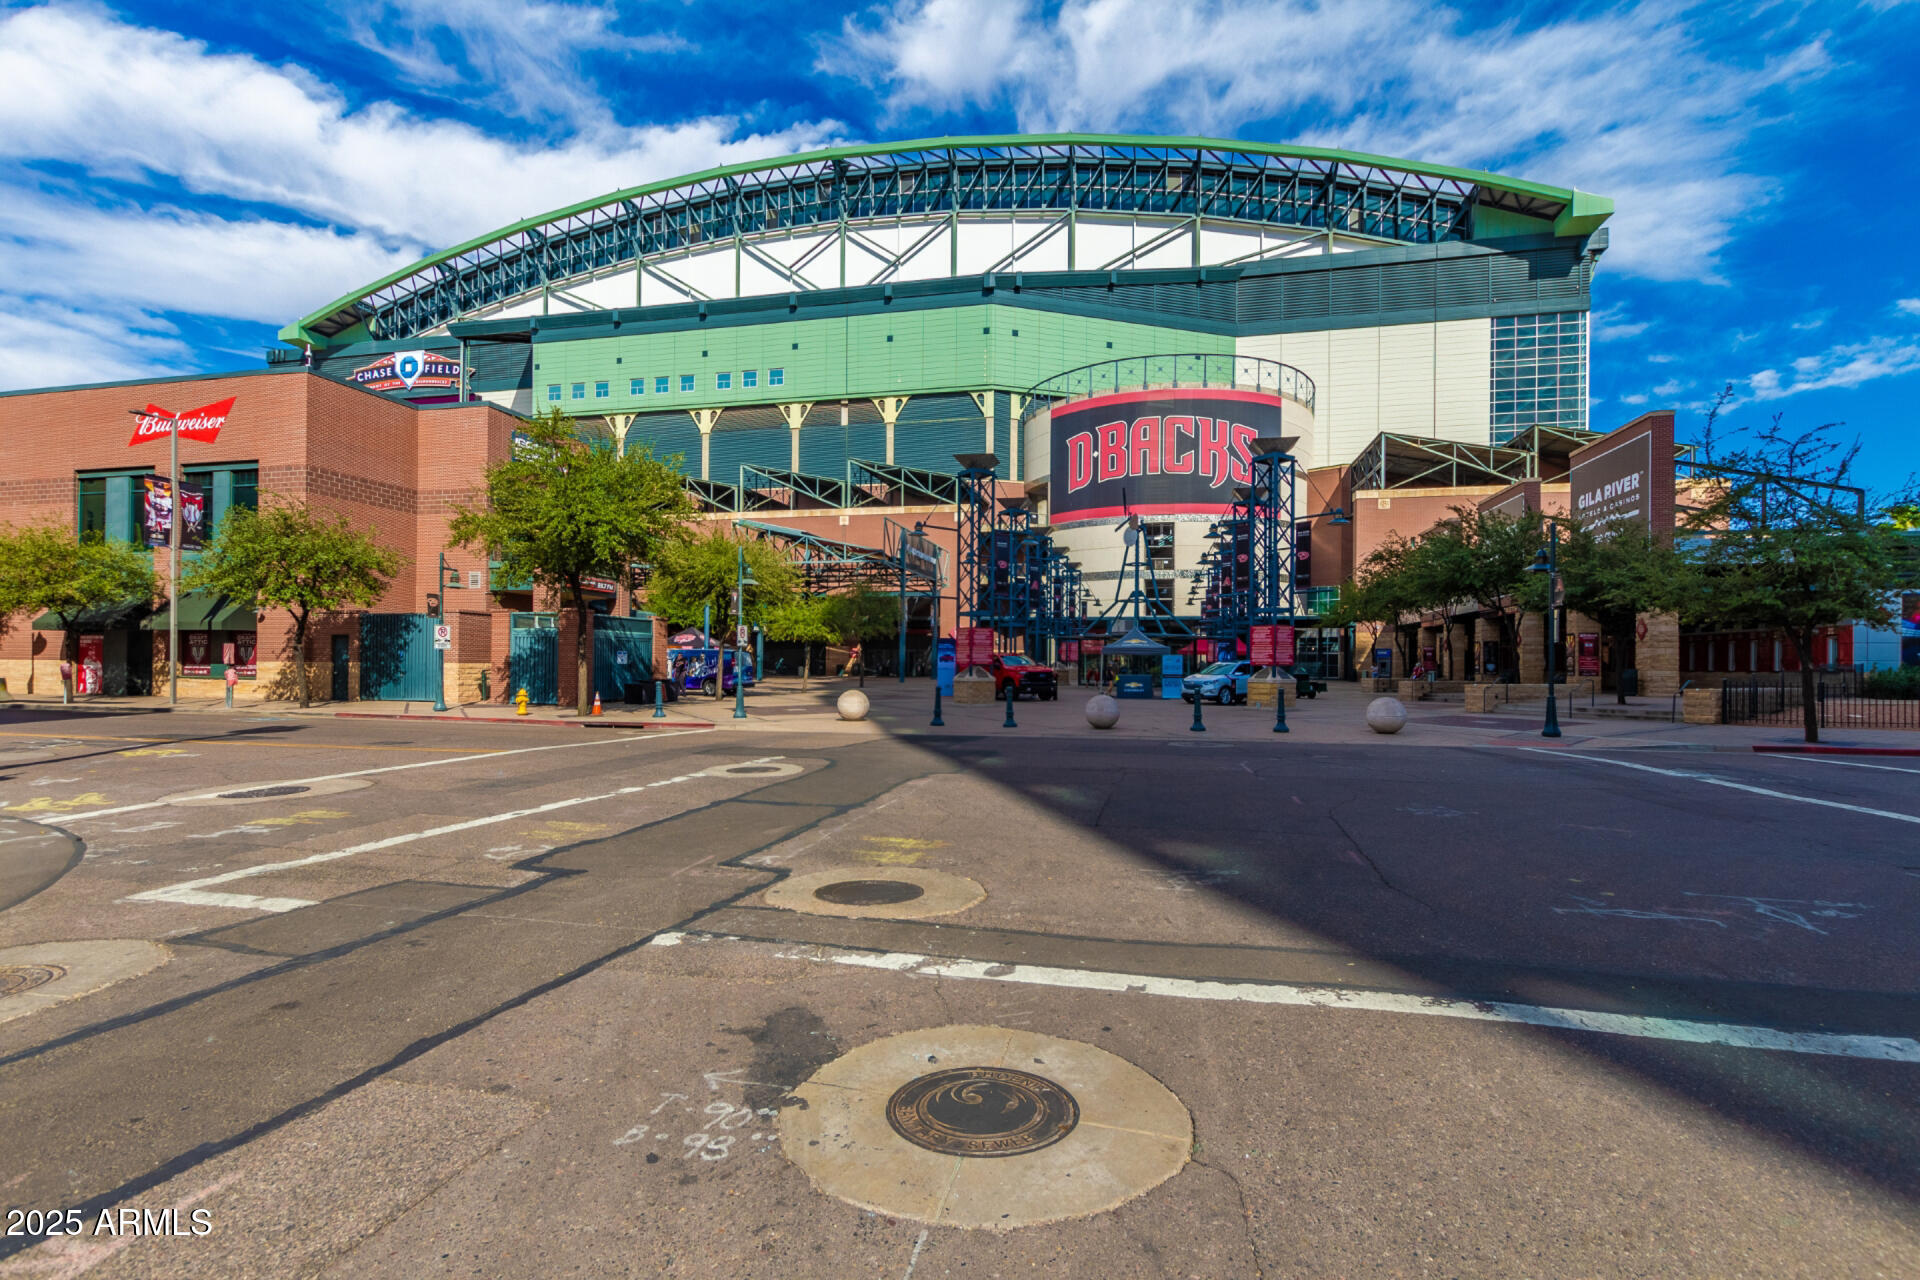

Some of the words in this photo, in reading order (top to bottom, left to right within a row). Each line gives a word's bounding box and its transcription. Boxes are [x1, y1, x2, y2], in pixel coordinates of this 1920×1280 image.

[357, 367, 392, 382] CHASE
[424, 363, 460, 374] FIELD
[1578, 488, 1602, 509] GILA
[1604, 473, 1639, 500] RIVER
[1609, 493, 1640, 510] CASINOS
[967, 1134, 1036, 1150] SEWER
